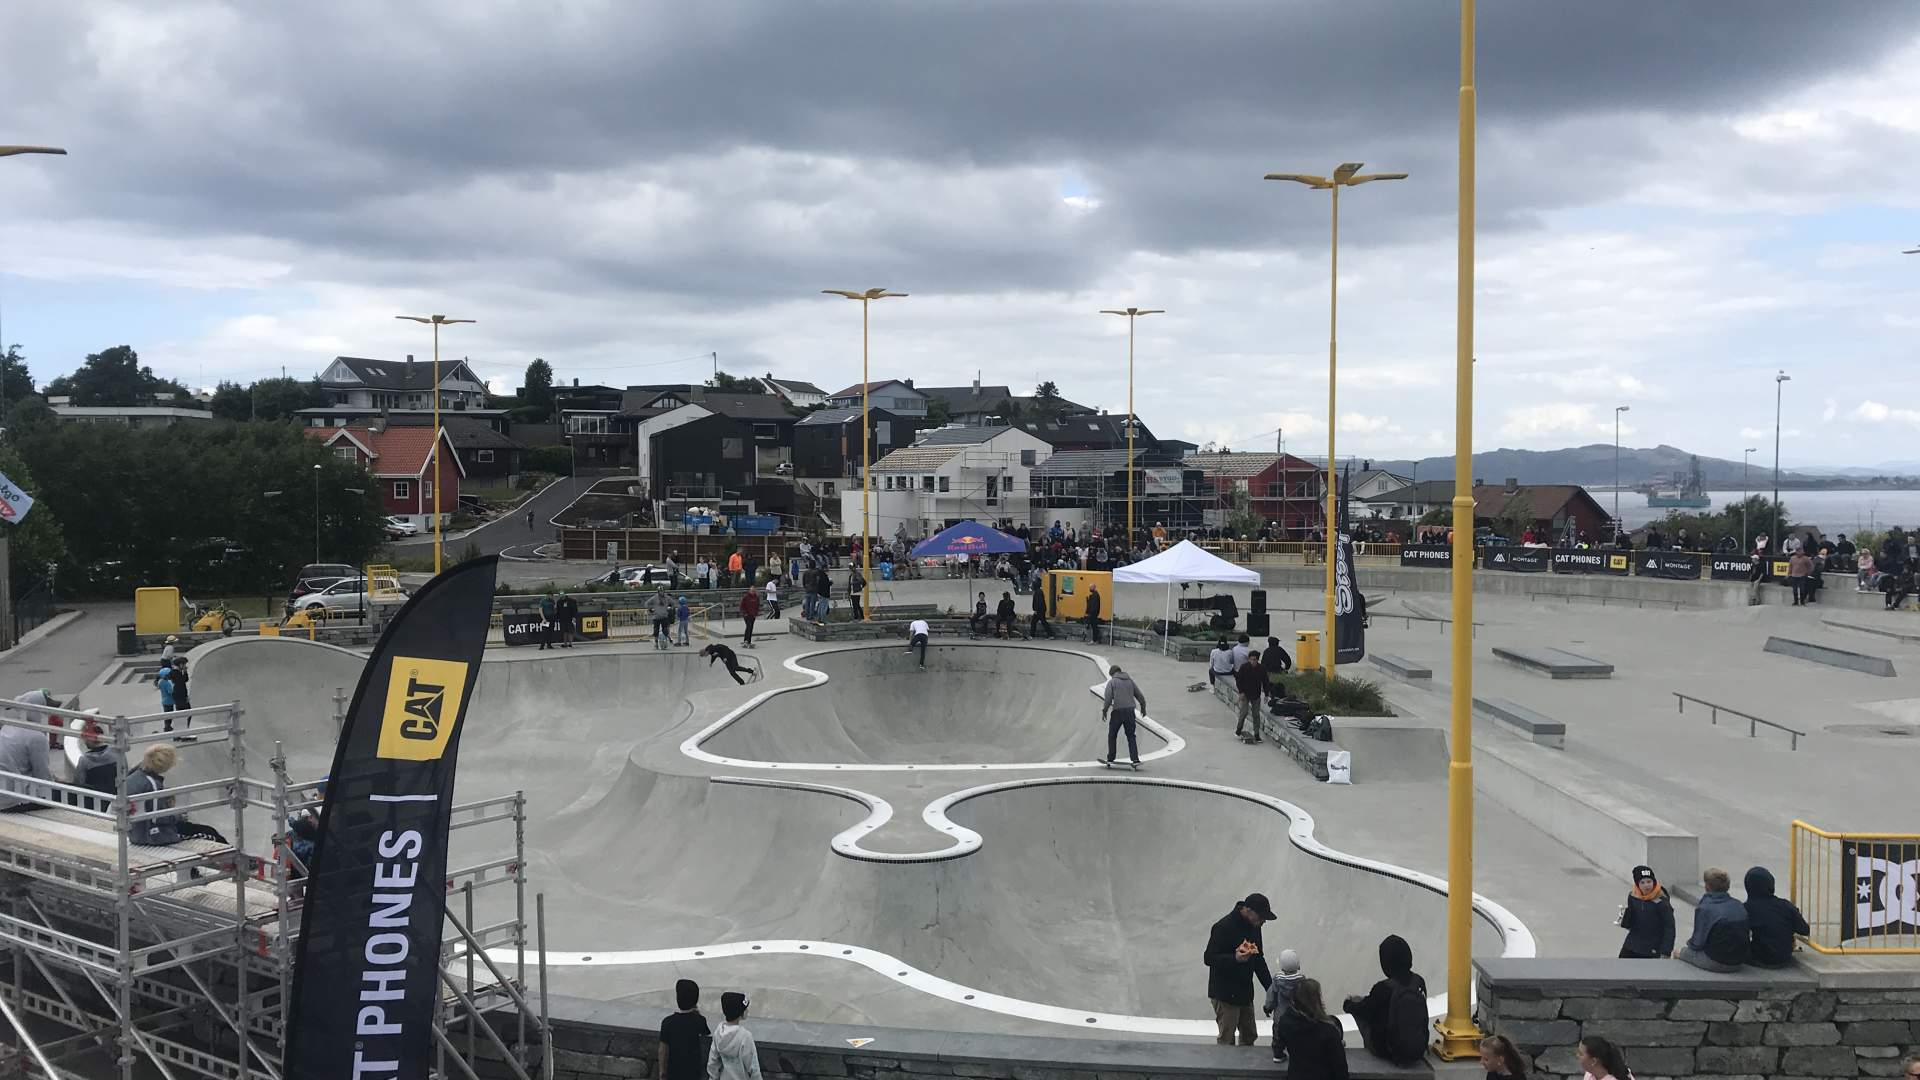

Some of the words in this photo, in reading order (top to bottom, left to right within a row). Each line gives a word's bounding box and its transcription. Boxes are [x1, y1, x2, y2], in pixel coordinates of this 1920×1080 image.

[1404, 550, 1418, 558] CAT
[1420, 550, 1450, 559] PHONES
[1555, 554, 1569, 563] CAT
[1571, 555, 1601, 564] PHONES
[1613, 558, 1623, 566] CAT
[1664, 561, 1692, 570] MONTAGE
[1714, 561, 1729, 571] CAT
[1730, 562, 1753, 571] PHON
[508, 623, 529, 634] CAT
[586, 620, 599, 628] CAT
[356, 829, 422, 1035] PHONES
